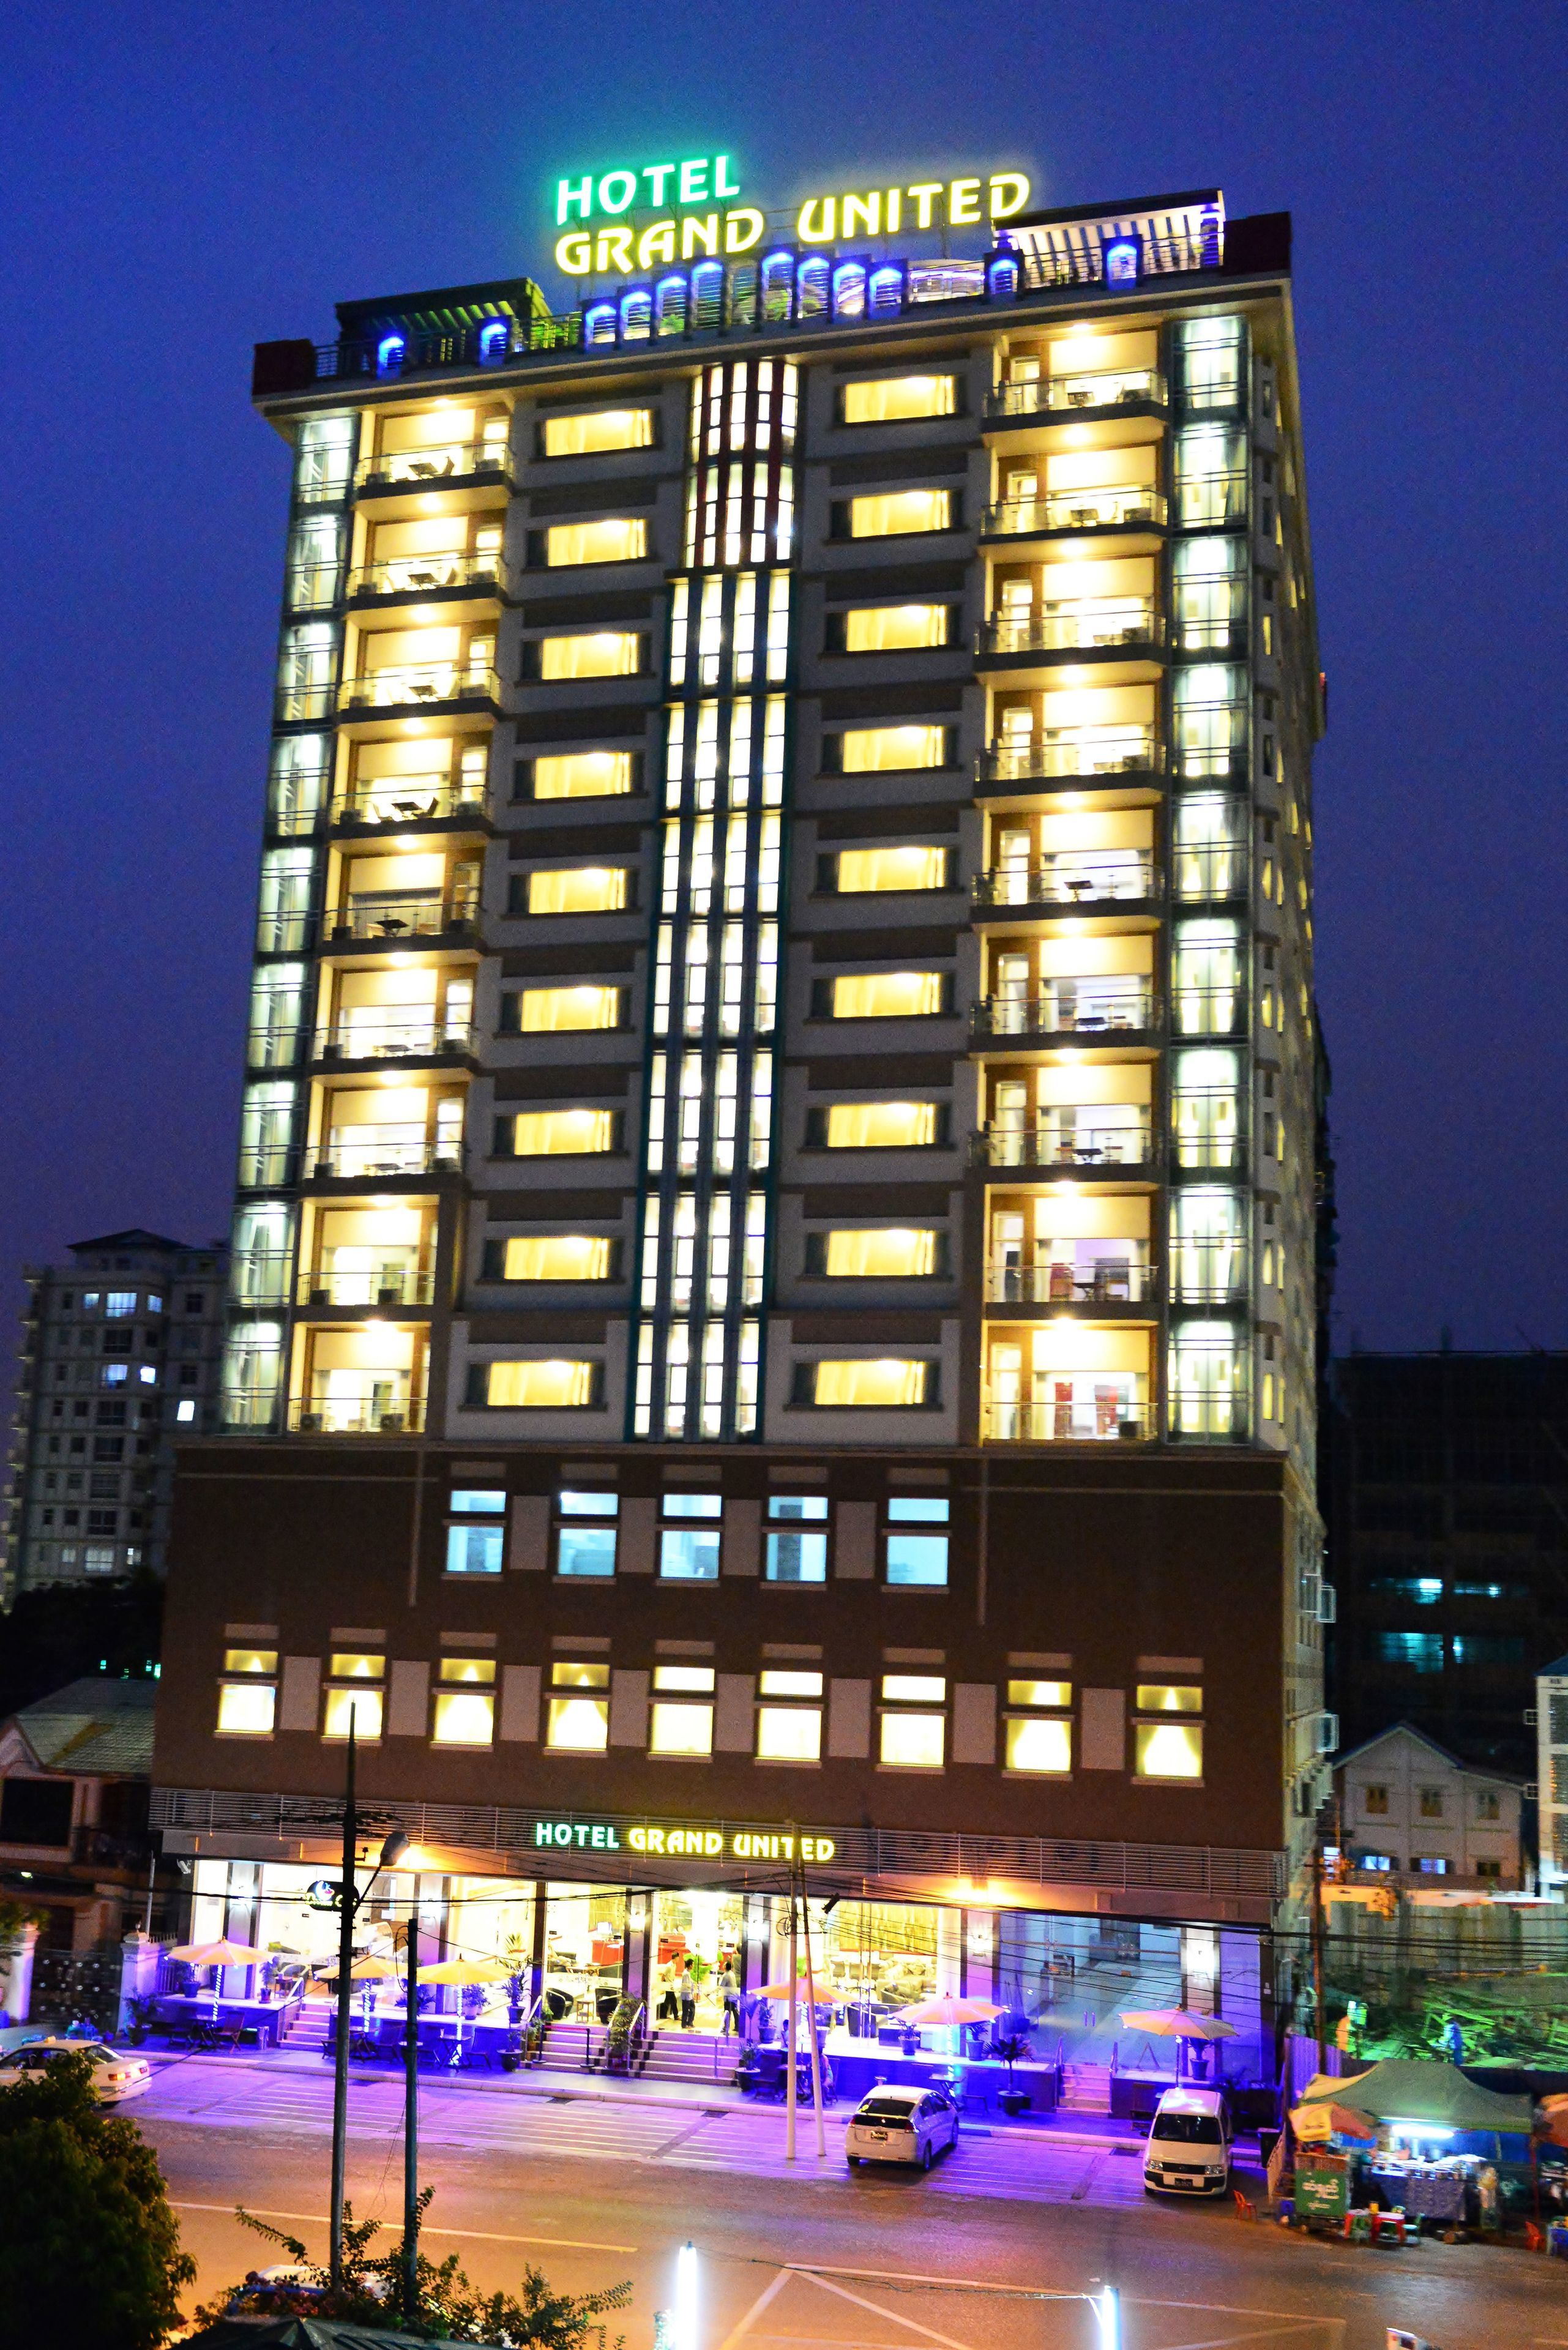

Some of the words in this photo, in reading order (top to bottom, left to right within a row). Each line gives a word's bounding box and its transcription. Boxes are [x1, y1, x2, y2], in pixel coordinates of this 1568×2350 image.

[555, 154, 741, 226] HOTEL
[555, 208, 765, 274] GRAND
[797, 172, 1031, 243] UNITED
[536, 1822, 619, 1849] HOTEL
[628, 1828, 723, 1854] GRAND
[733, 1833, 835, 1860] UNITED
